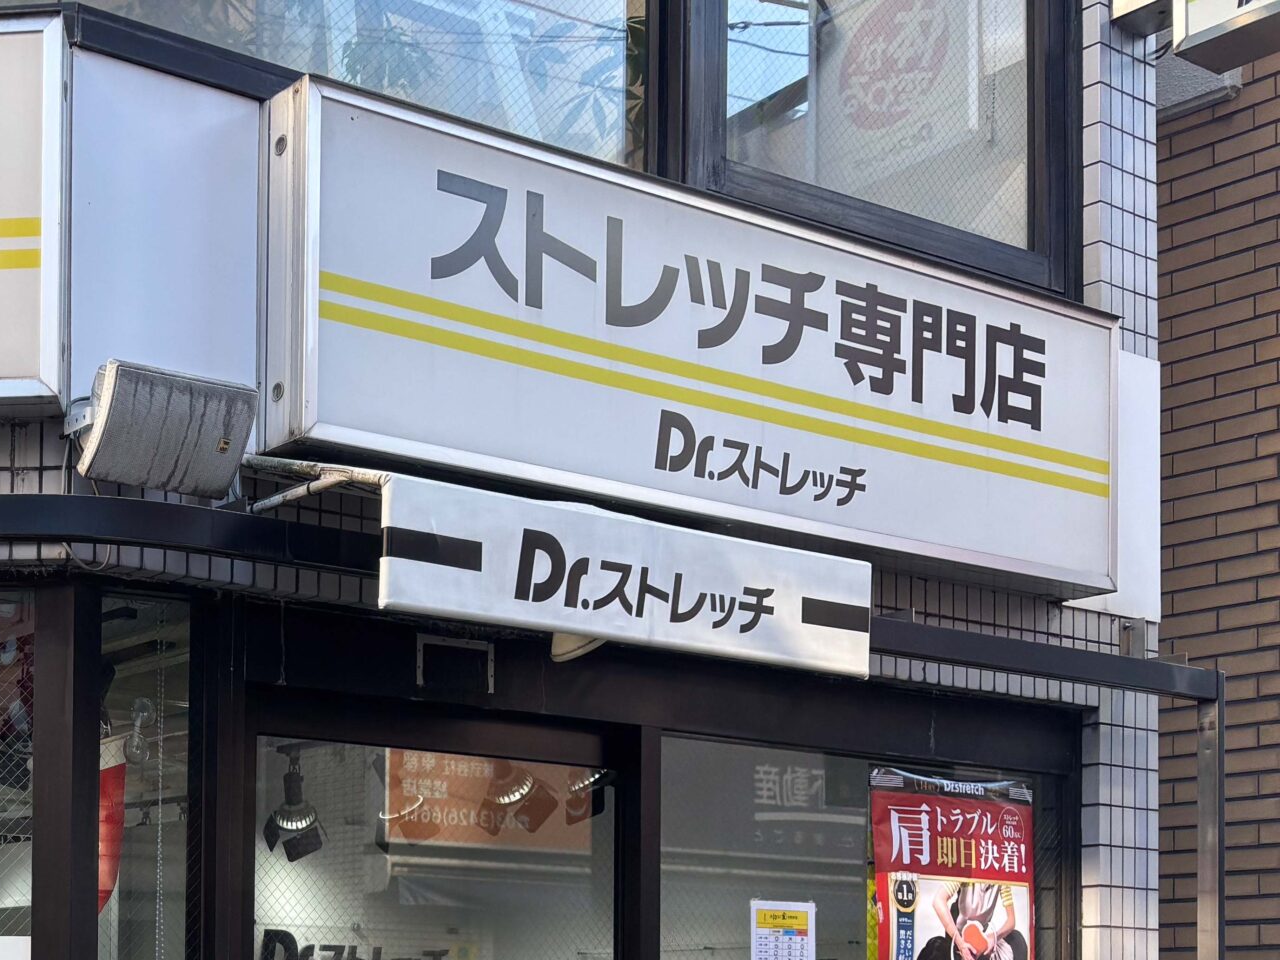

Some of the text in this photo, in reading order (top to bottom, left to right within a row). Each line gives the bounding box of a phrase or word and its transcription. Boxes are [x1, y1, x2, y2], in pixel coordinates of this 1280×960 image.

[430, 170, 1047, 431] ストレッチ専門店
[655, 409, 866, 507] Dr.ストレッチ
[514, 527, 775, 633] Dr.ストレッチ
[888, 803, 931, 866] 肩
[936, 806, 998, 835] トラブル
